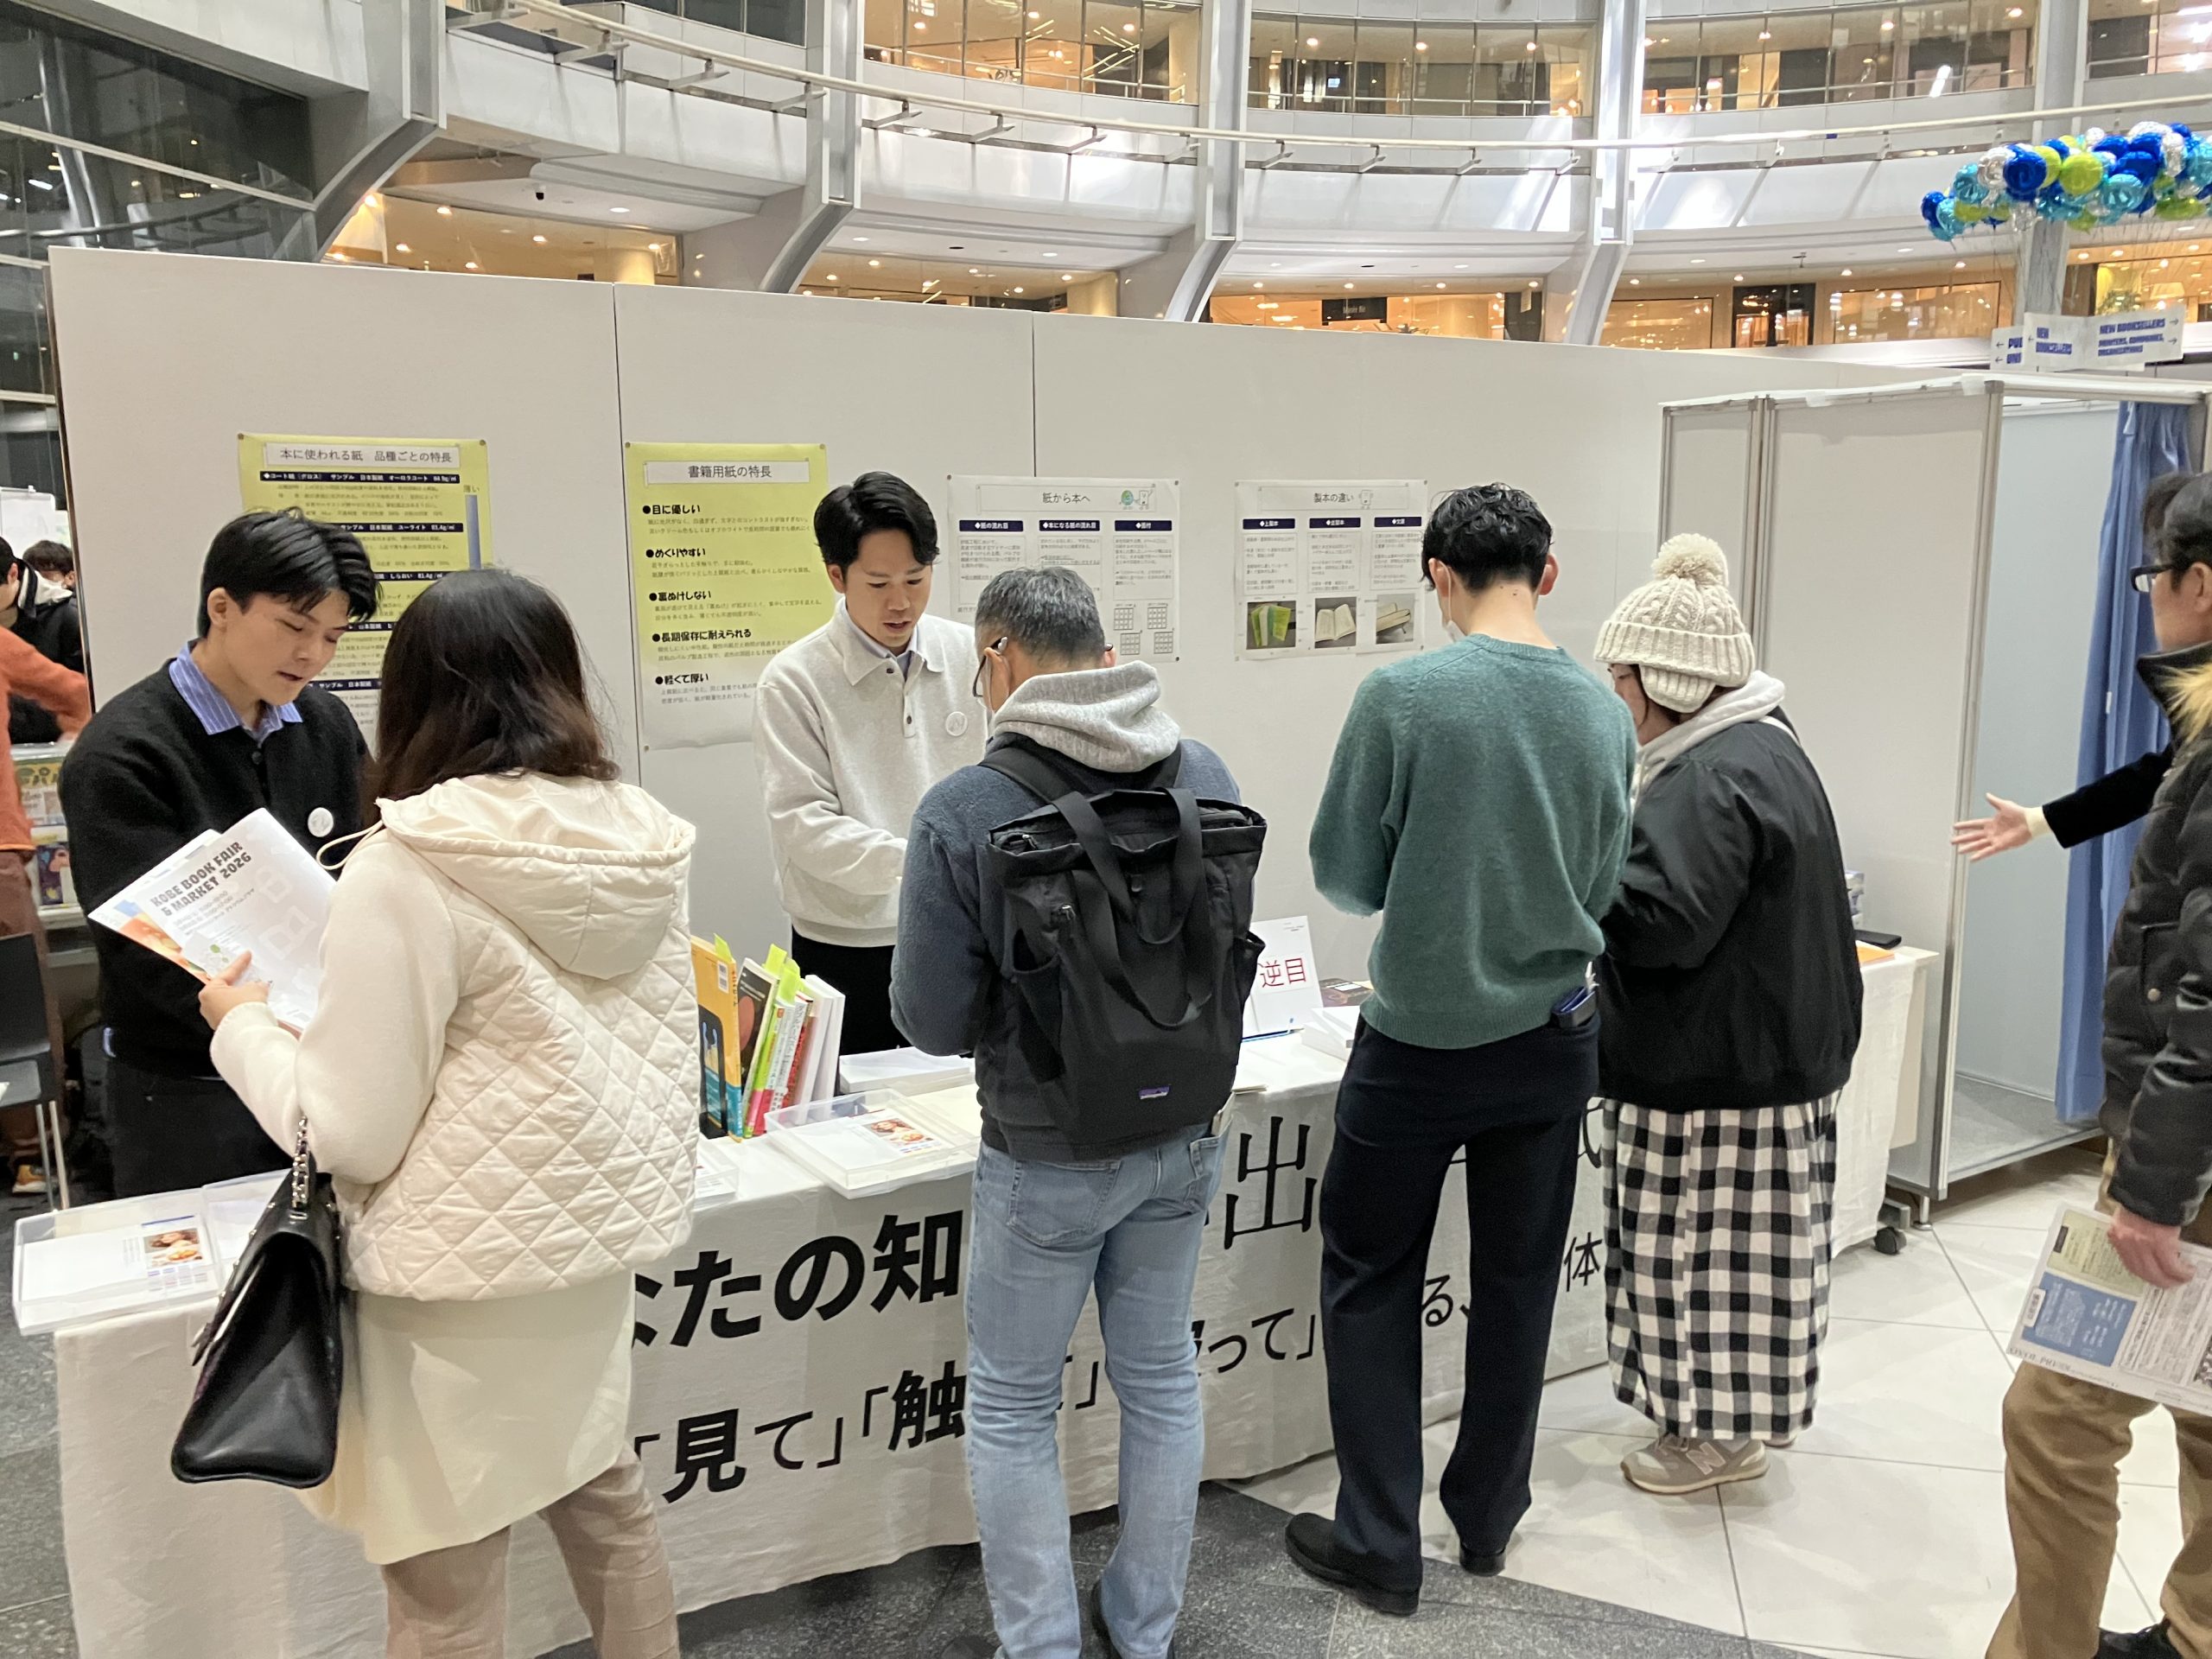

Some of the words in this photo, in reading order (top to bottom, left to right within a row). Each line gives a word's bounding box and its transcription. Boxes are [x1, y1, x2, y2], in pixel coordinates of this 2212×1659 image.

[280, 448, 363, 461] 本に使われる紙
[374, 450, 453, 463] 品種ごとの特長
[688, 465, 772, 479] 書籍用紙の特長
[1042, 493, 1090, 504] 紙から本へ
[1313, 493, 1355, 503] 製本の違い
[652, 504, 702, 515] 目に優しい
[654, 548, 707, 558] めくりやすい
[658, 590, 712, 602] 裏ぬけしない
[661, 628, 753, 643] 長期保存に耐えられる
[664, 673, 709, 685] 軽くて厚い
[150, 885, 184, 907] KOBE
[180, 861, 217, 890] BOOK
[213, 842, 244, 867] FAIR
[170, 875, 219, 912] MARKET
[219, 852, 252, 879] 2026
[1257, 957, 1306, 988] 逆目
[1224, 1116, 1319, 1250] 出
